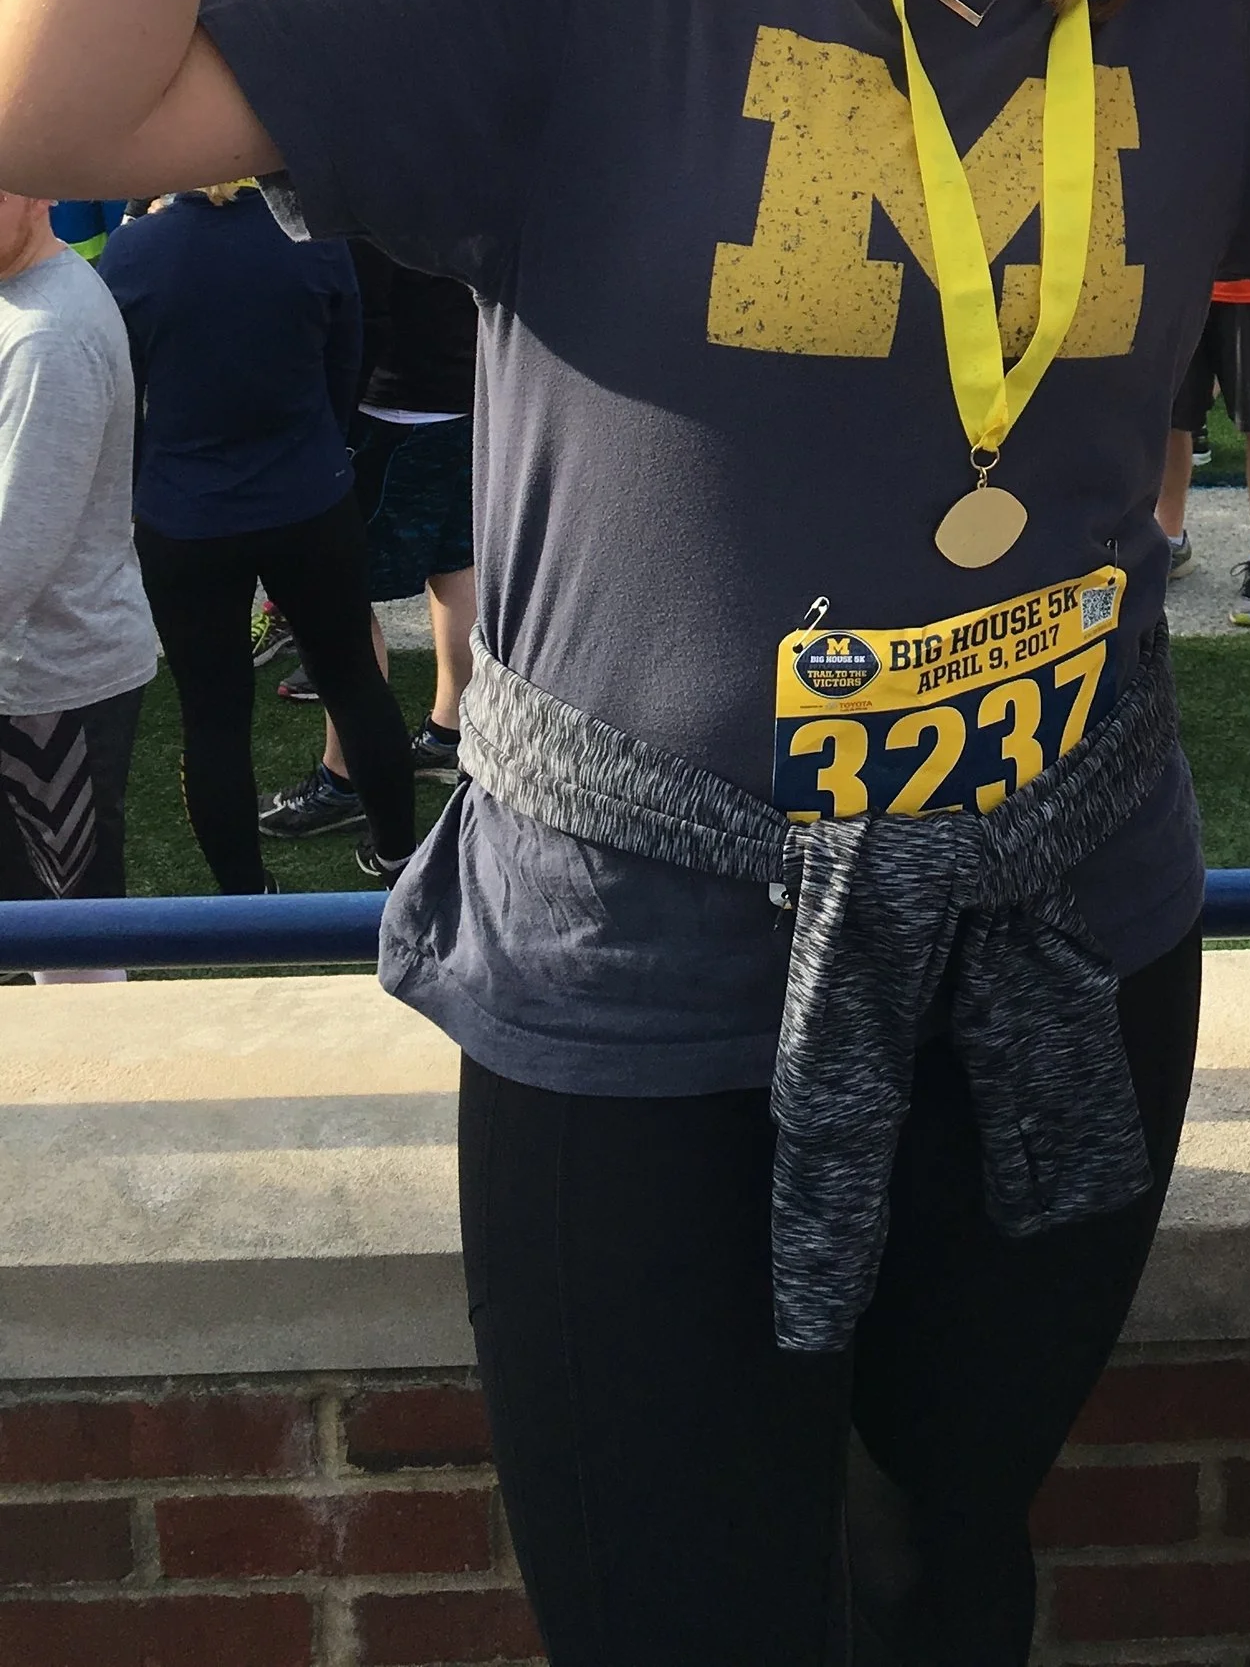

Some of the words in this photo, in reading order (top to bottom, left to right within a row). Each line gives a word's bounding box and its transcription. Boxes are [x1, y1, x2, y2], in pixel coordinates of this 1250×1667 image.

[706, 24, 1146, 358] M
[889, 634, 944, 672] BIG
[950, 605, 1043, 655] HOUSE
[1047, 584, 1083, 619] 5K
[826, 638, 851, 655] M
[810, 655, 825, 663] BIG
[826, 655, 853, 664] HOUSE
[853, 655, 866, 663] 5K
[916, 651, 984, 695] APRIL
[988, 648, 1010, 670] 9,
[1014, 624, 1061, 661] 2017
[807, 670, 834, 678] TRAIL
[835, 670, 848, 678] TO
[849, 670, 867, 678] THE
[813, 677, 862, 687] VICTORS
[840, 700, 873, 709] TOYOTA
[786, 639, 1107, 818] 3237
